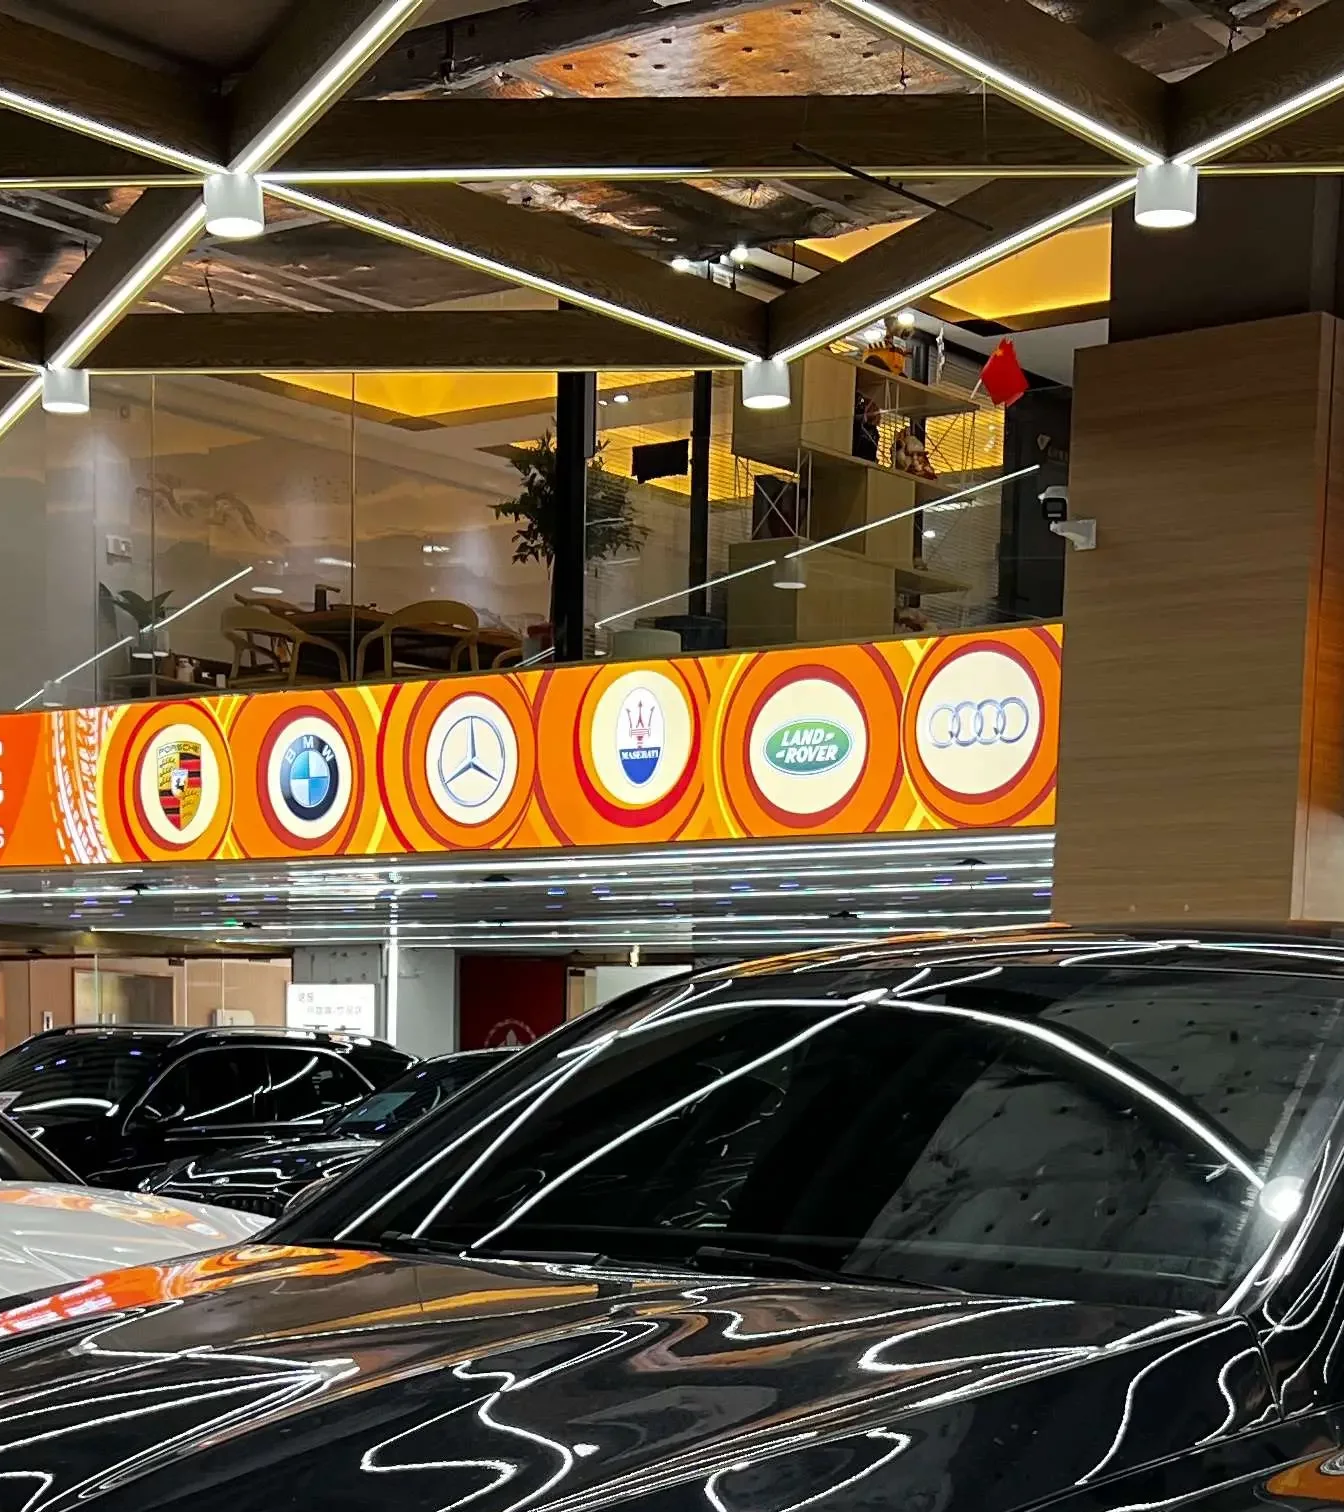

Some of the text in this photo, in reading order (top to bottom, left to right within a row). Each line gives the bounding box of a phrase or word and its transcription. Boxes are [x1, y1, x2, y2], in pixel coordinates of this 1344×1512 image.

[158, 742, 200, 756] PORSCHE
[285, 735, 335, 764] BMW
[621, 749, 659, 760] MASERATI
[784, 745, 838, 763] ROVER
